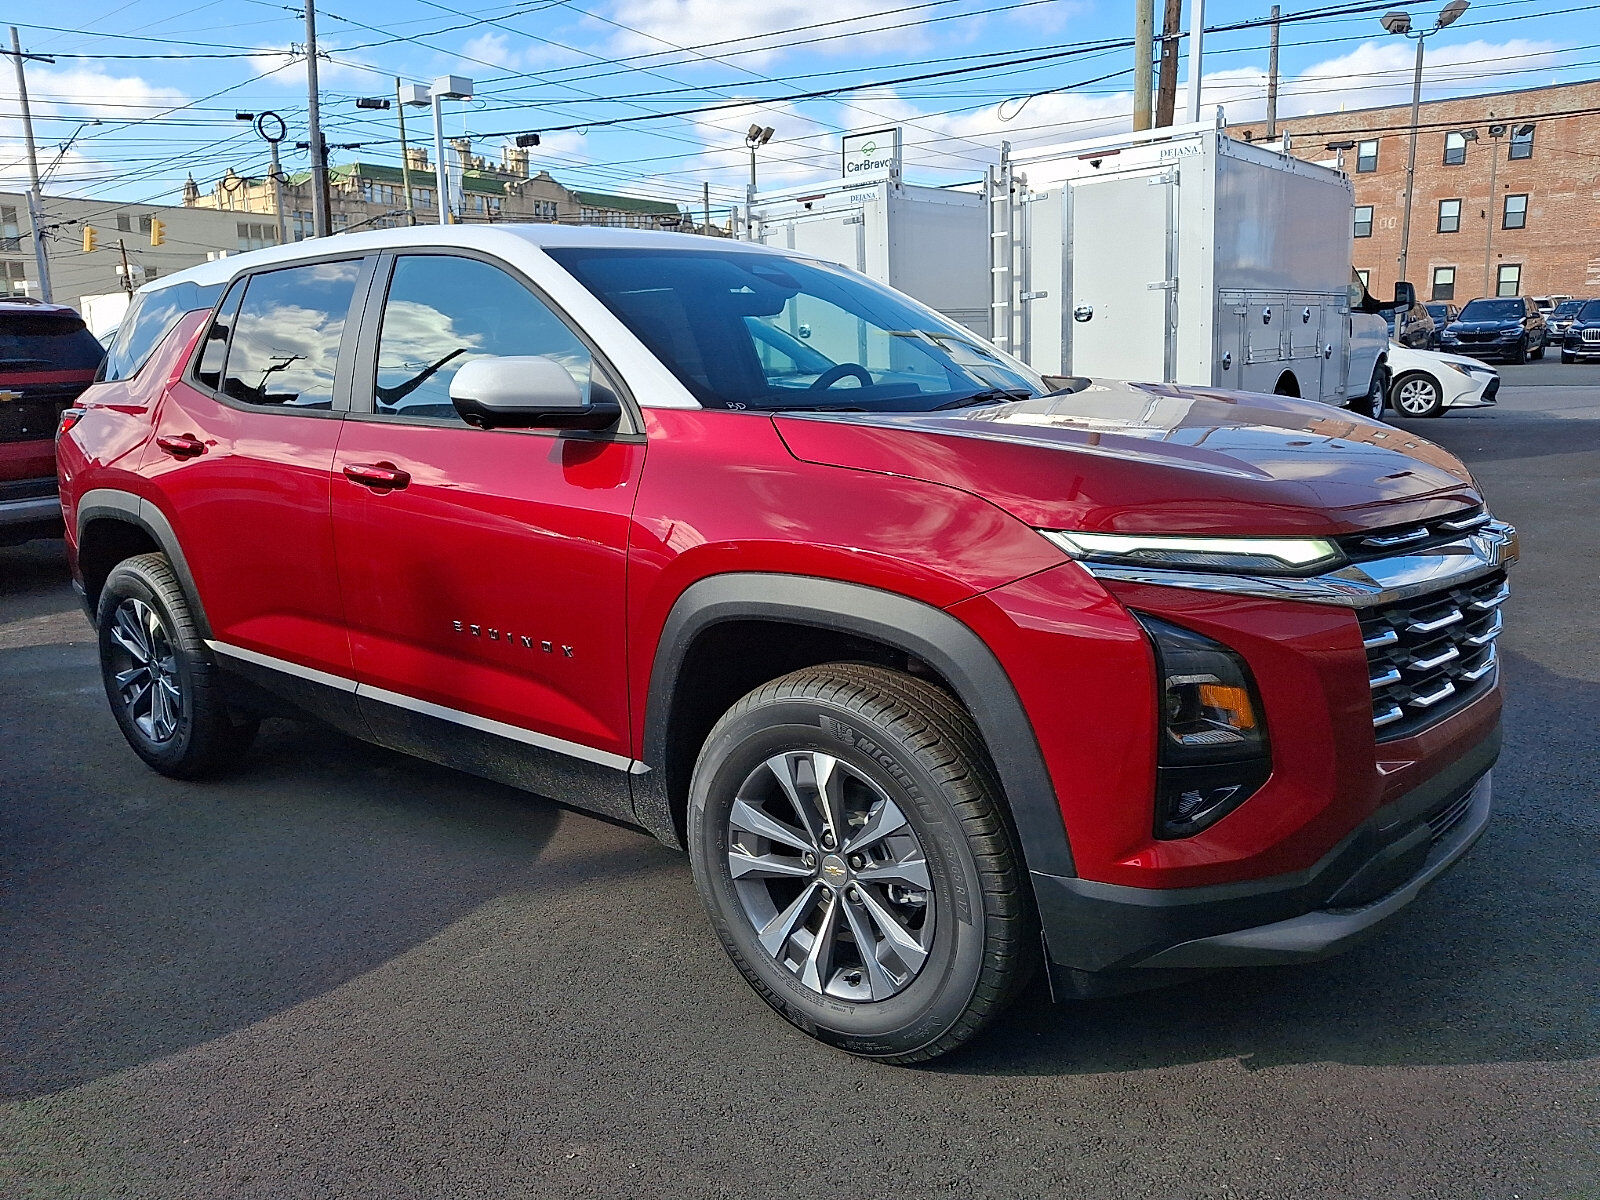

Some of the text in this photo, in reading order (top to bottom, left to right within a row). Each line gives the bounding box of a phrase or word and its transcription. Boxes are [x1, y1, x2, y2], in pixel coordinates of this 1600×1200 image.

[847, 159, 891, 173] CarBravo
[452, 620, 575, 659] EQUINOX
[855, 737, 933, 818] MICHELIN
